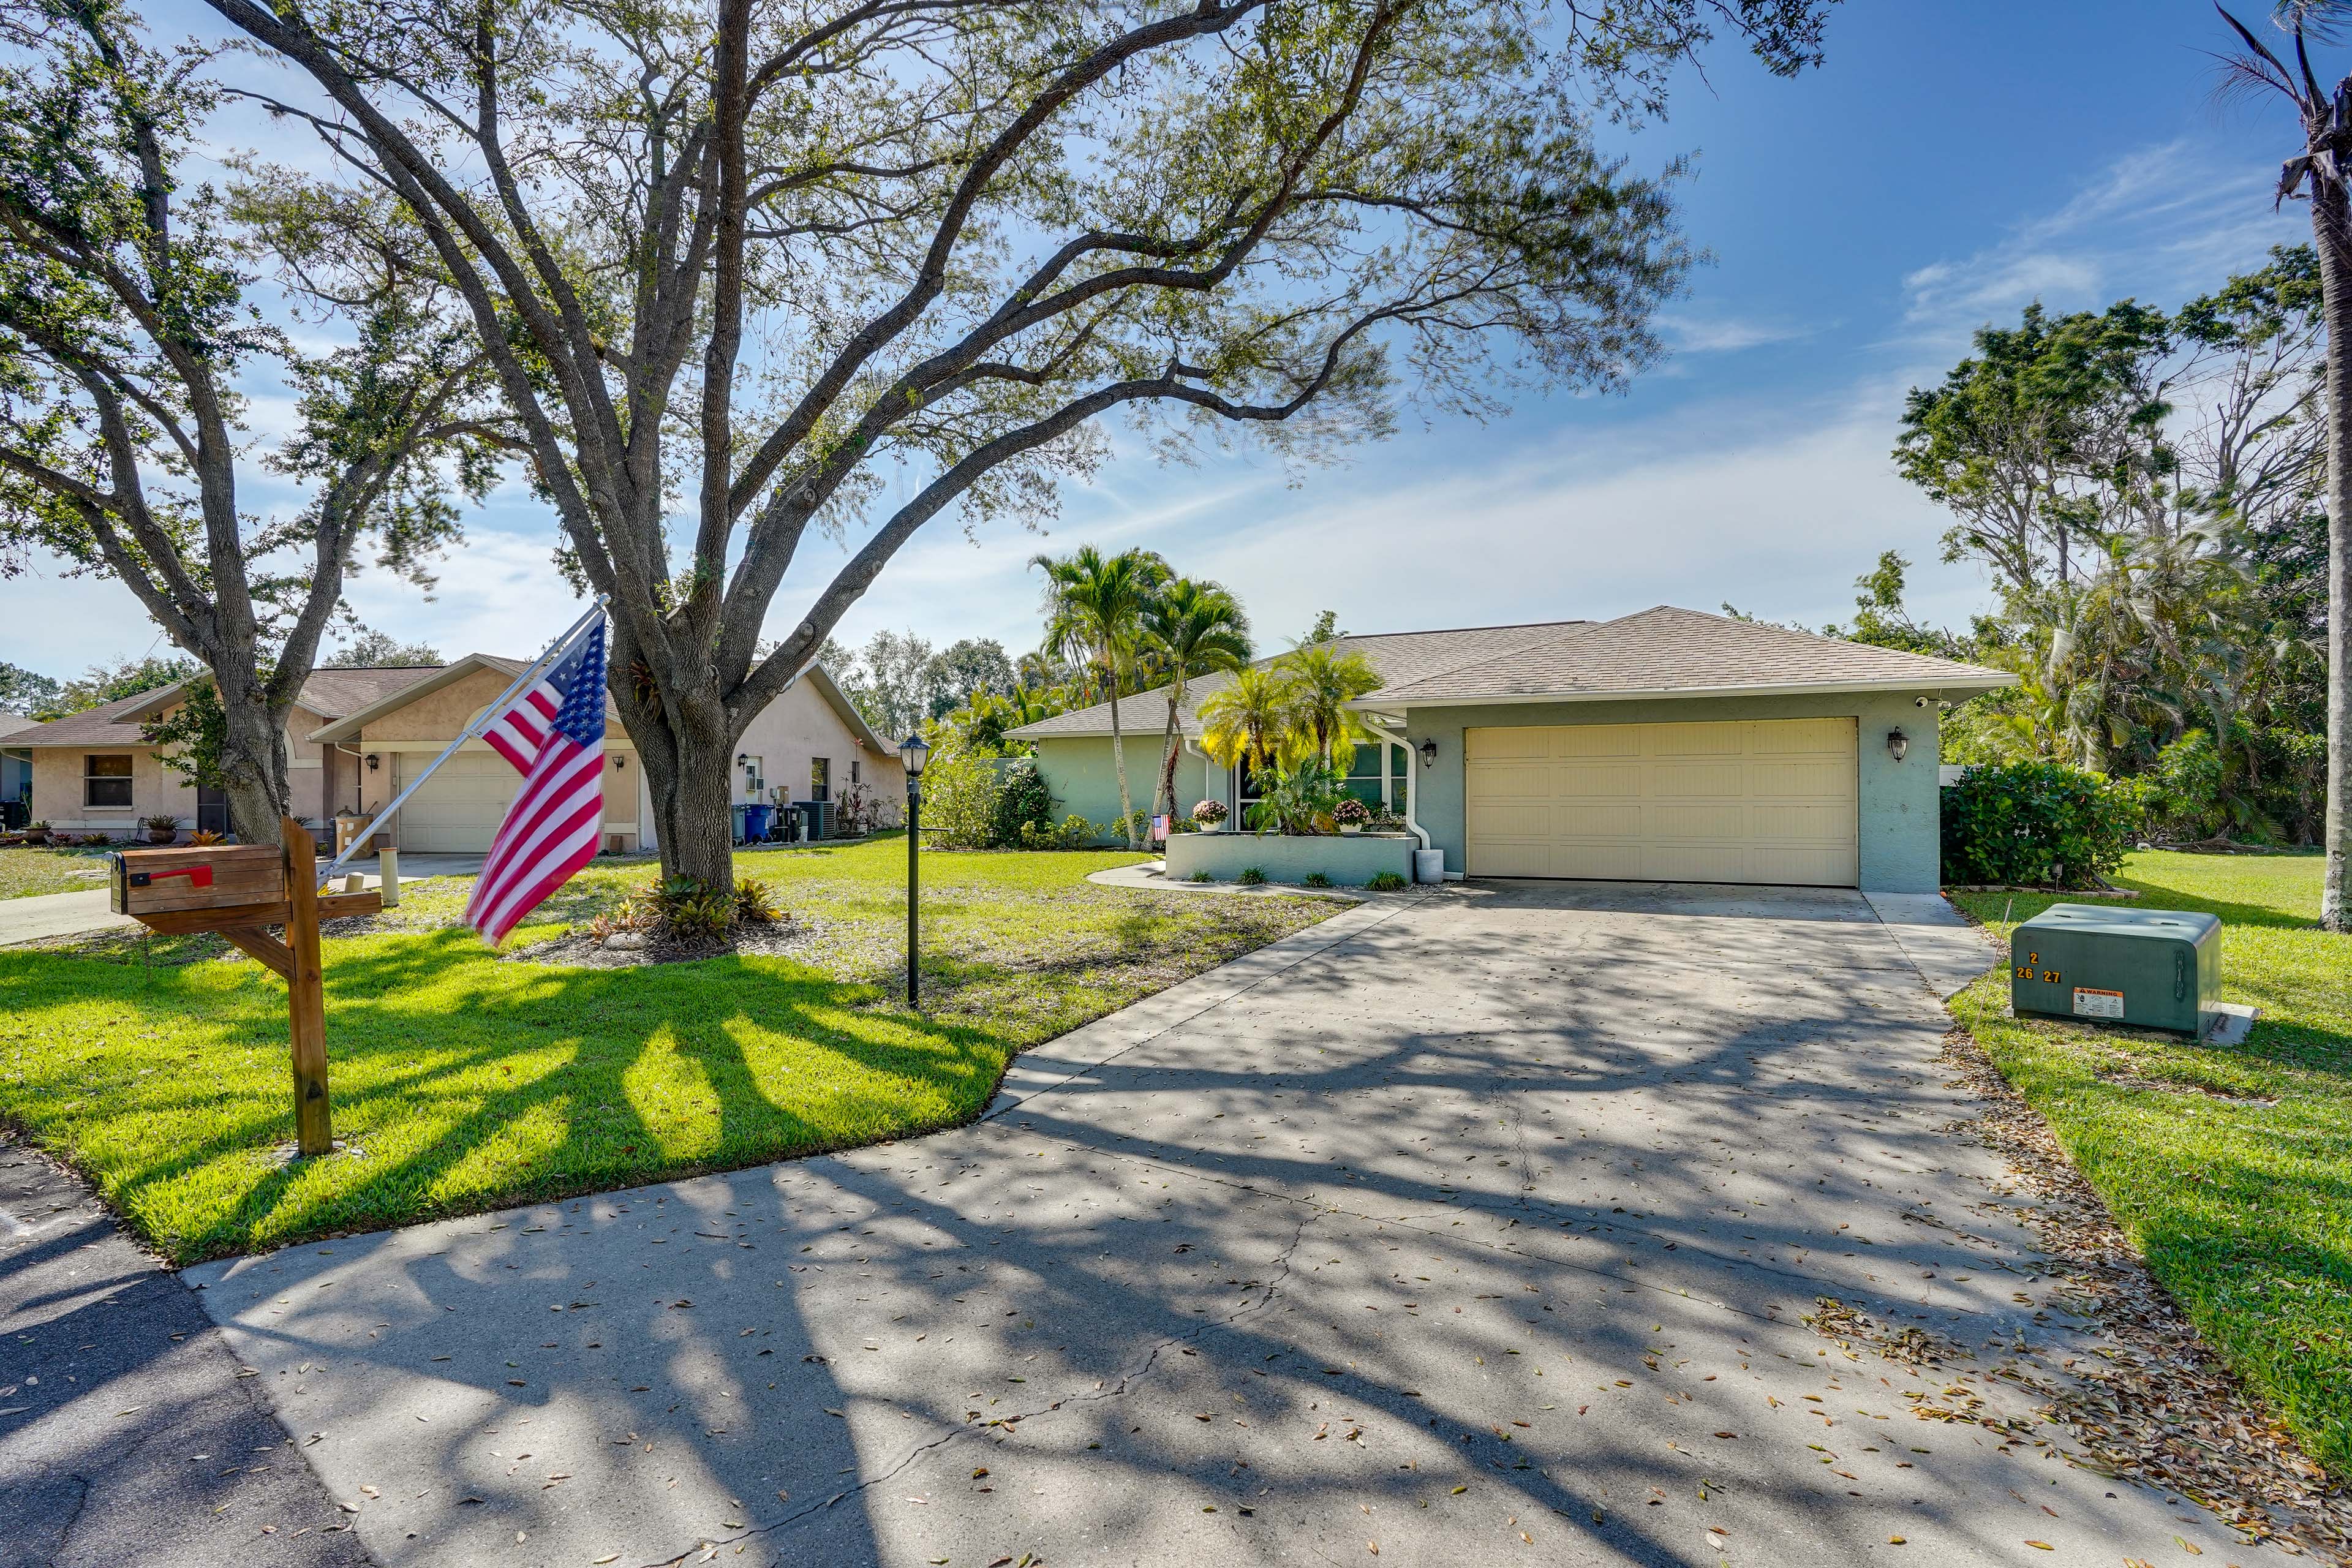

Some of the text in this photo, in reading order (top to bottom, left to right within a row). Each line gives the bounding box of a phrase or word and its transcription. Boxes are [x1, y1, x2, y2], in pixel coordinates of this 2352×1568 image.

[2030, 952, 2038, 964] 2
[2017, 967, 2060, 983] 26 27
